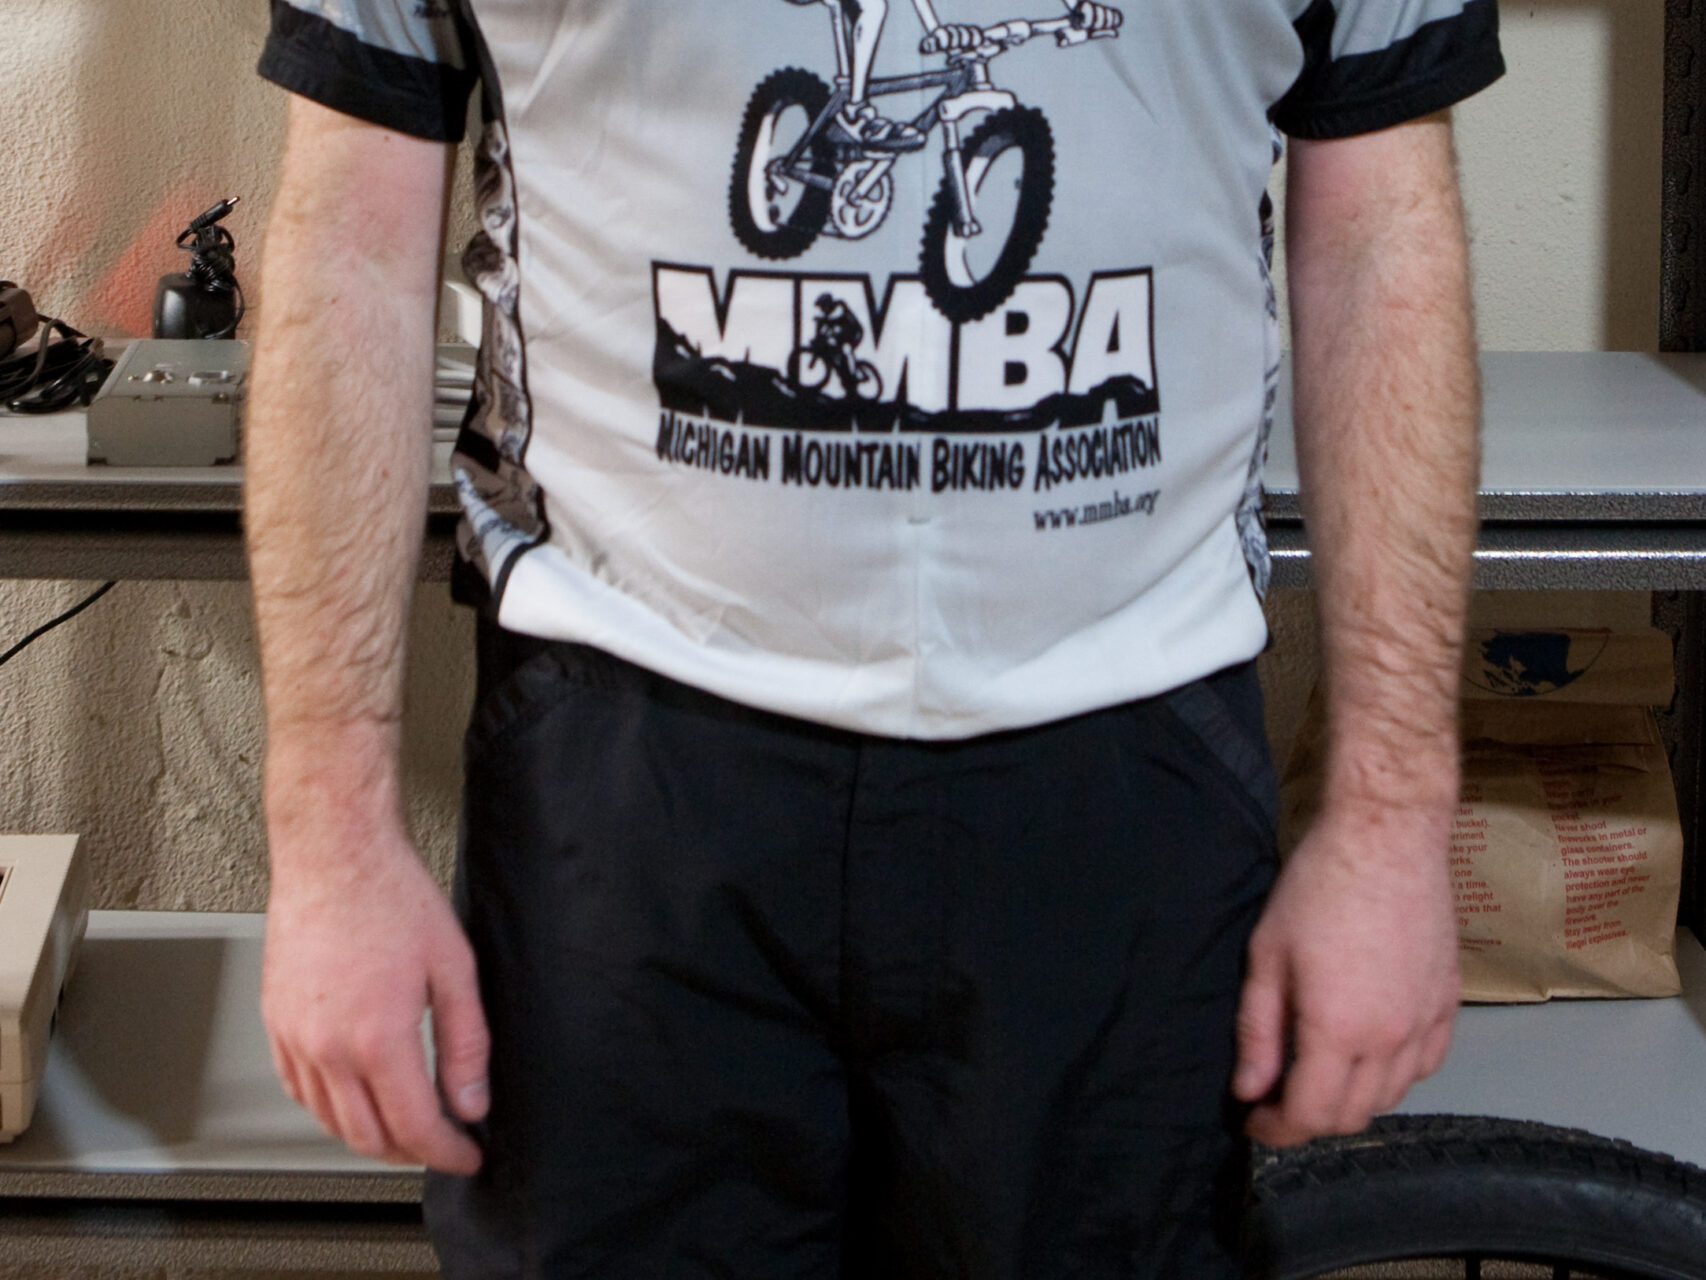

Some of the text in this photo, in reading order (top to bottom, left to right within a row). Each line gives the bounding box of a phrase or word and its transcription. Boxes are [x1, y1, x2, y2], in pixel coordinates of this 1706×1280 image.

[651, 260, 1161, 432] MMBA
[656, 412, 1161, 494] MICHIGAN MOUNTAIN BIKING ASSOCIATION
[1580, 820, 1607, 831] shoot
[1599, 832, 1608, 841] in
[1610, 827, 1636, 840] metal
[1637, 826, 1647, 836] or
[1562, 851, 1648, 866] The shooter should
[1454, 869, 1473, 878] one
[1564, 870, 1596, 880] always
[1565, 879, 1610, 893] protection
